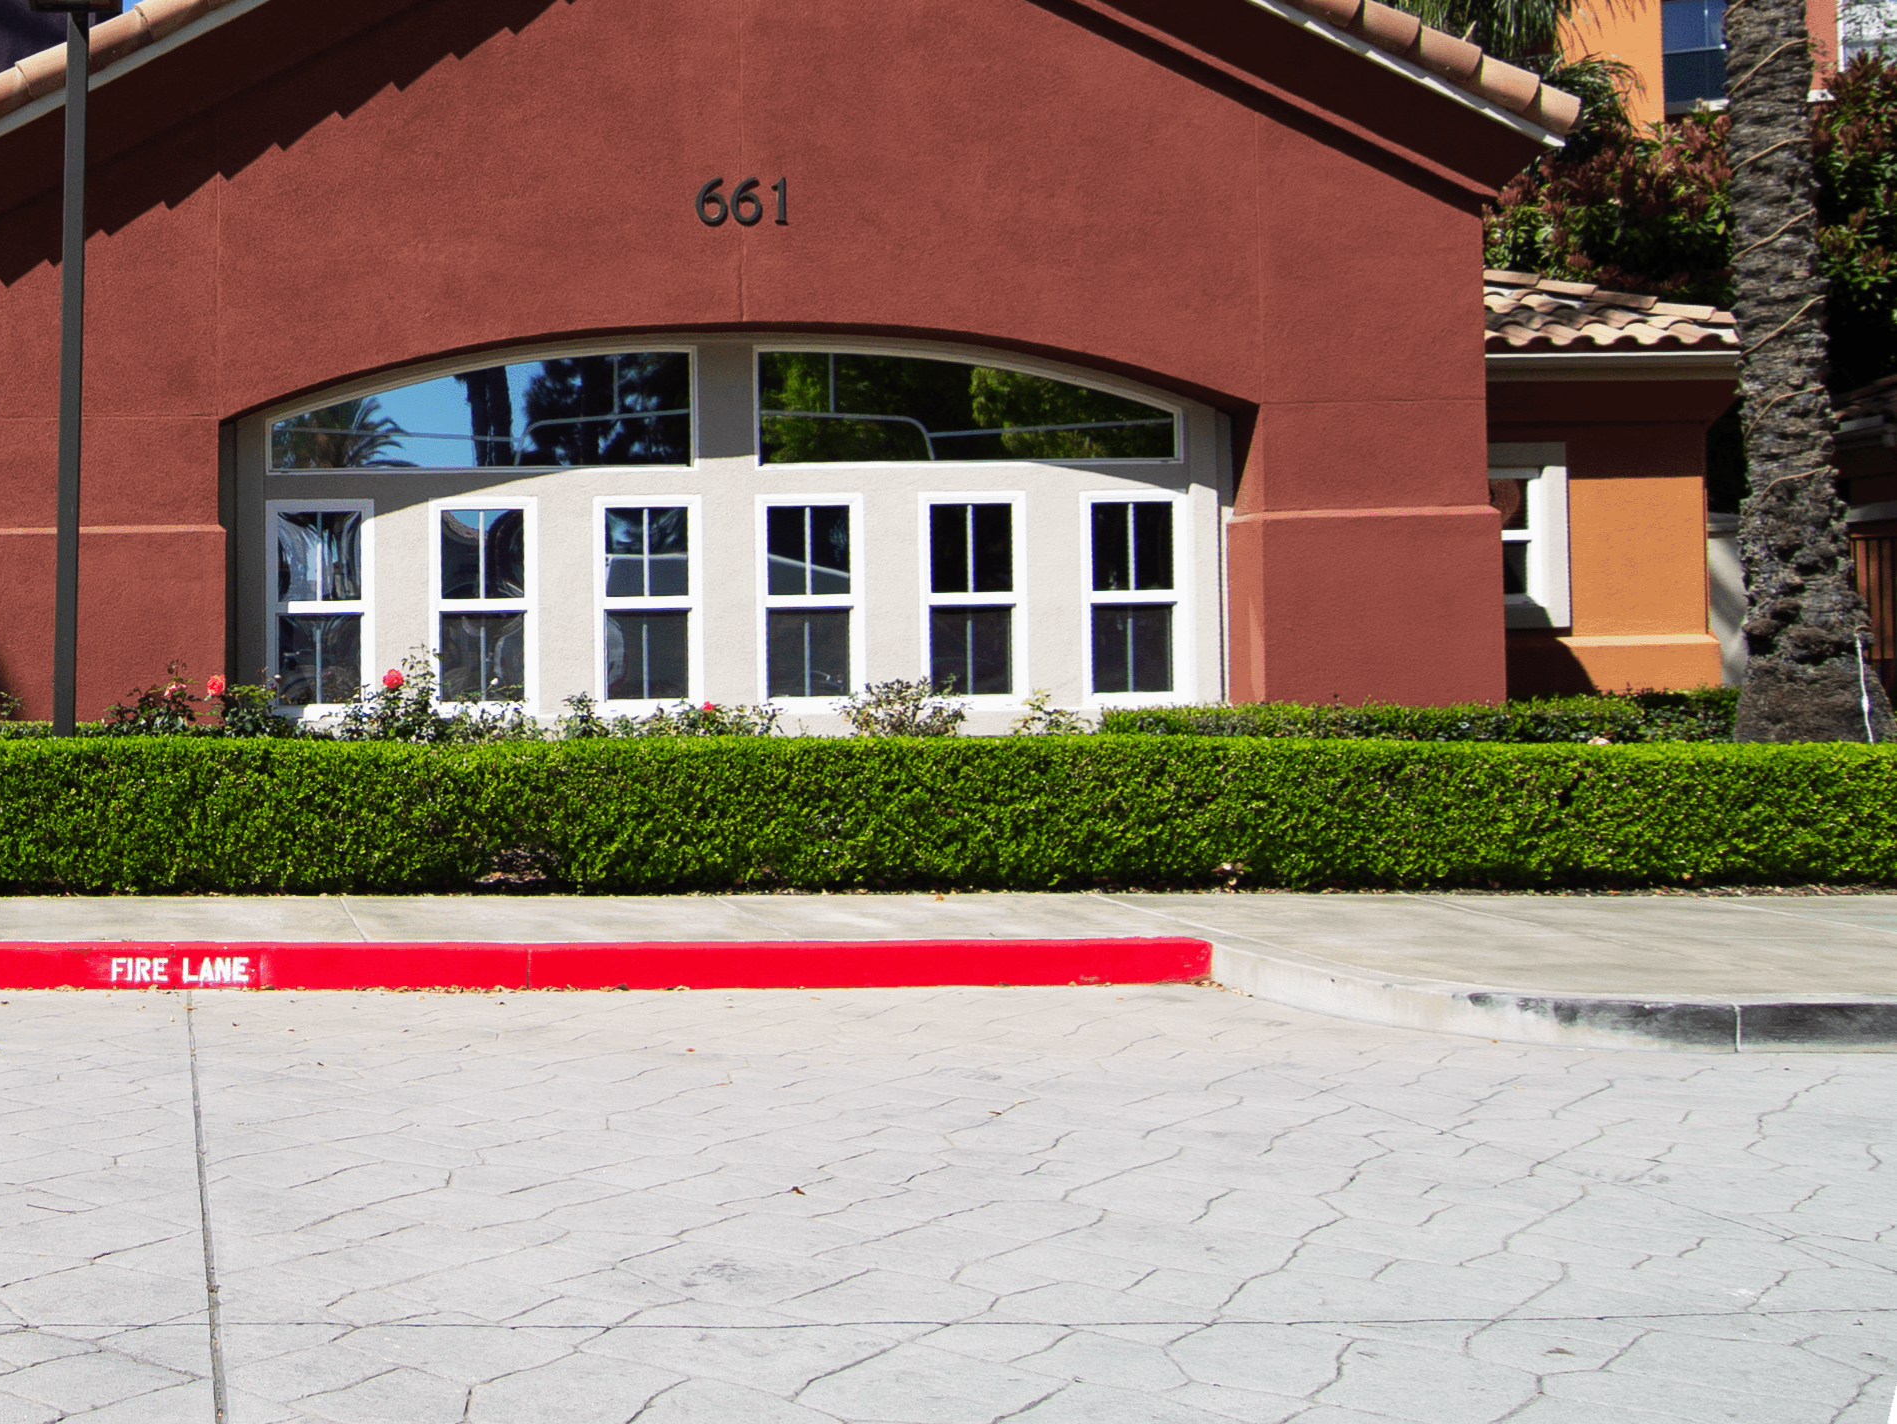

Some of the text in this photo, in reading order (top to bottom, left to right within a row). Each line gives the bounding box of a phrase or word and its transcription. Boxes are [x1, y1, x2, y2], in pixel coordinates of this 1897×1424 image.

[695, 176, 789, 226] 661
[111, 957, 250, 983] FIRE LANE
